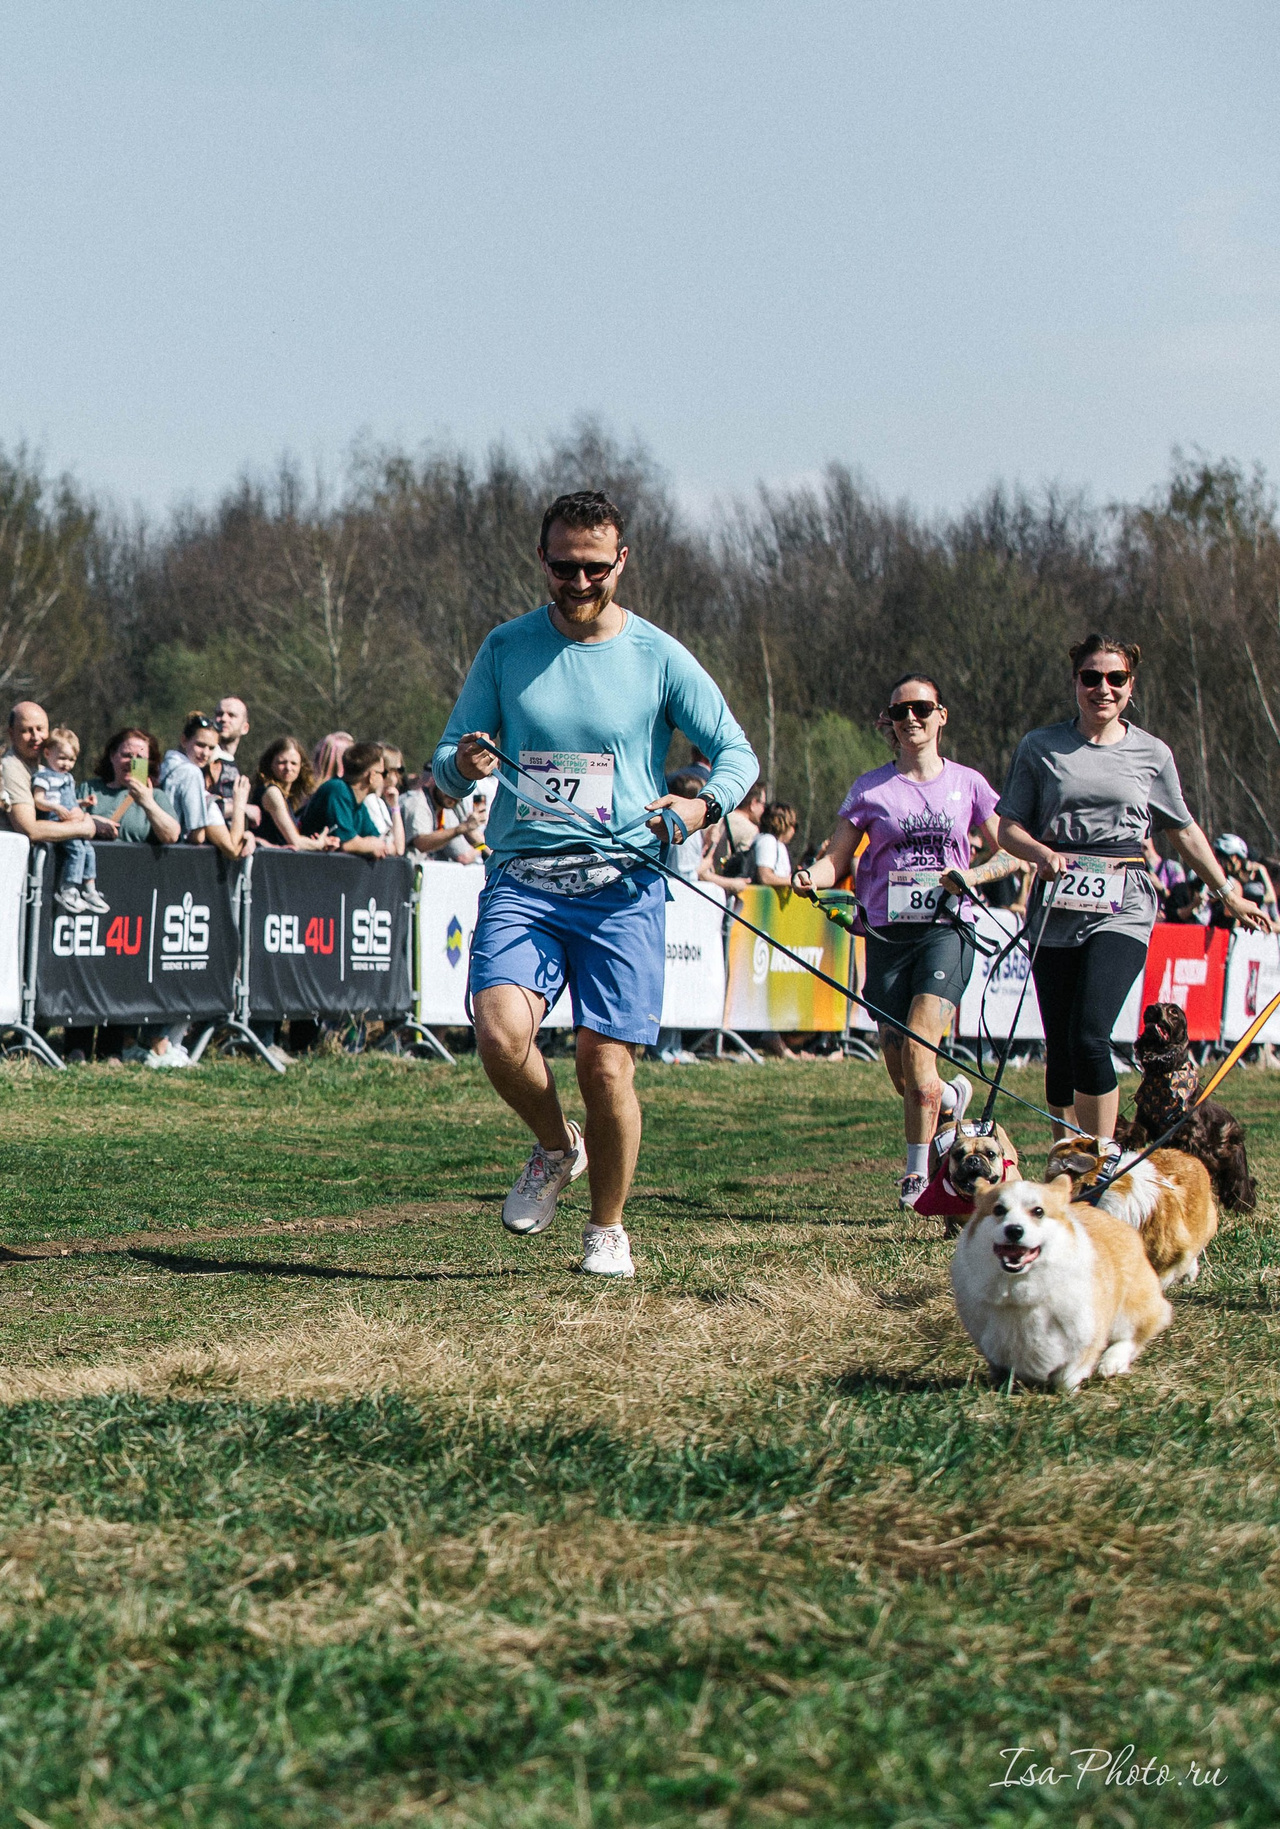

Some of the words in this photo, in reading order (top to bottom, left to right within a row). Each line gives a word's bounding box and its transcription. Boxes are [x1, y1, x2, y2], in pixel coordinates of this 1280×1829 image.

[545, 778, 580, 803] 37
[894, 835, 959, 853] FINISHER
[911, 857, 945, 866] 2025
[1061, 874, 1105, 898] 263
[910, 890, 936, 910] 86
[53, 915, 142, 956] GEL4U
[264, 914, 334, 954] GEL4U
[666, 942, 701, 966] арафон
